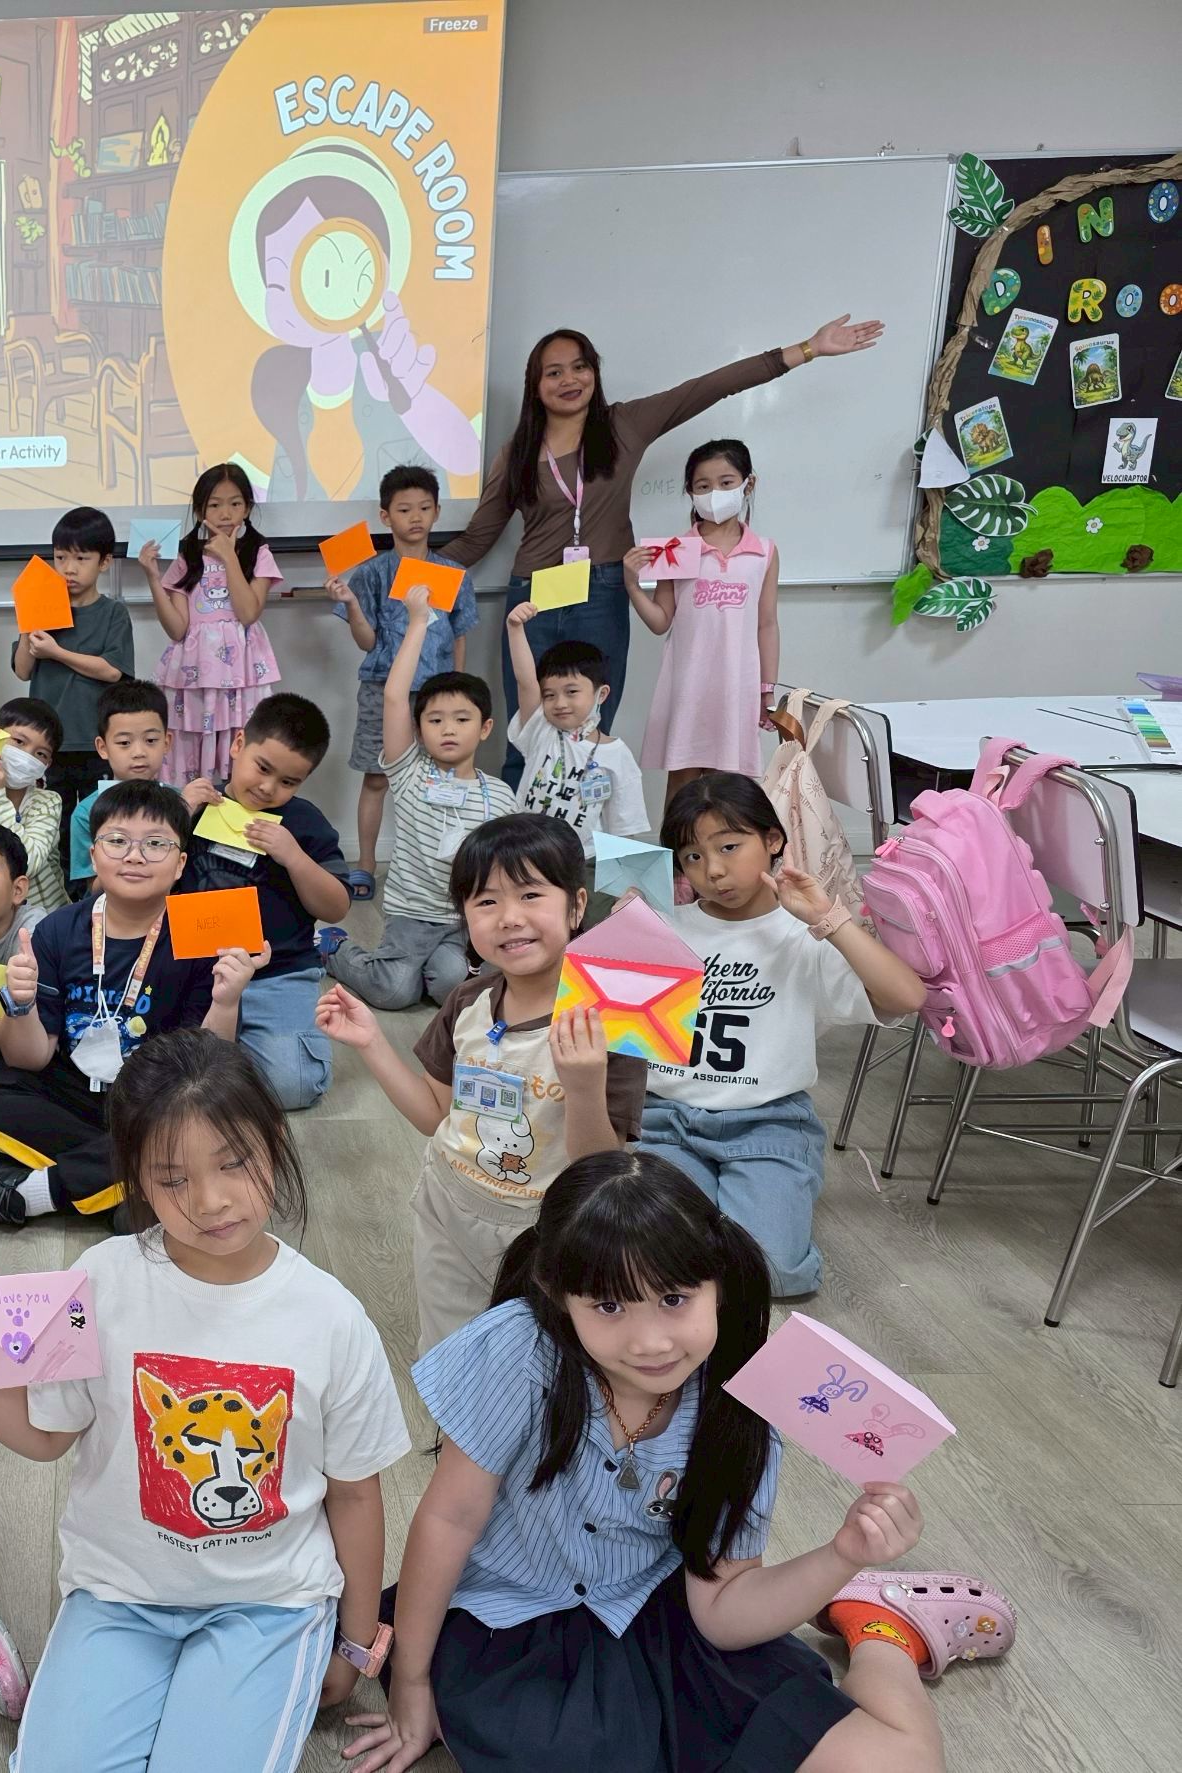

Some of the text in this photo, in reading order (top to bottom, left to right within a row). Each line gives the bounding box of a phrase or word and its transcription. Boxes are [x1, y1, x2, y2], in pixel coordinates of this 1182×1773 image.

[430, 18, 478, 32] Freeze
[274, 74, 476, 280] ESCAPE ROOM
[1074, 339, 1115, 352] Spinosaurus
[10, 443, 62, 463] Activity
[1102, 474, 1149, 483] VELOCIRAPTOR
[695, 590, 748, 608] Bunny
[692, 1072, 759, 1086] ASSOCIATION
[25, 1293, 51, 1306] you
[157, 1530, 273, 1554] FASTEST CAT IN TOWN
